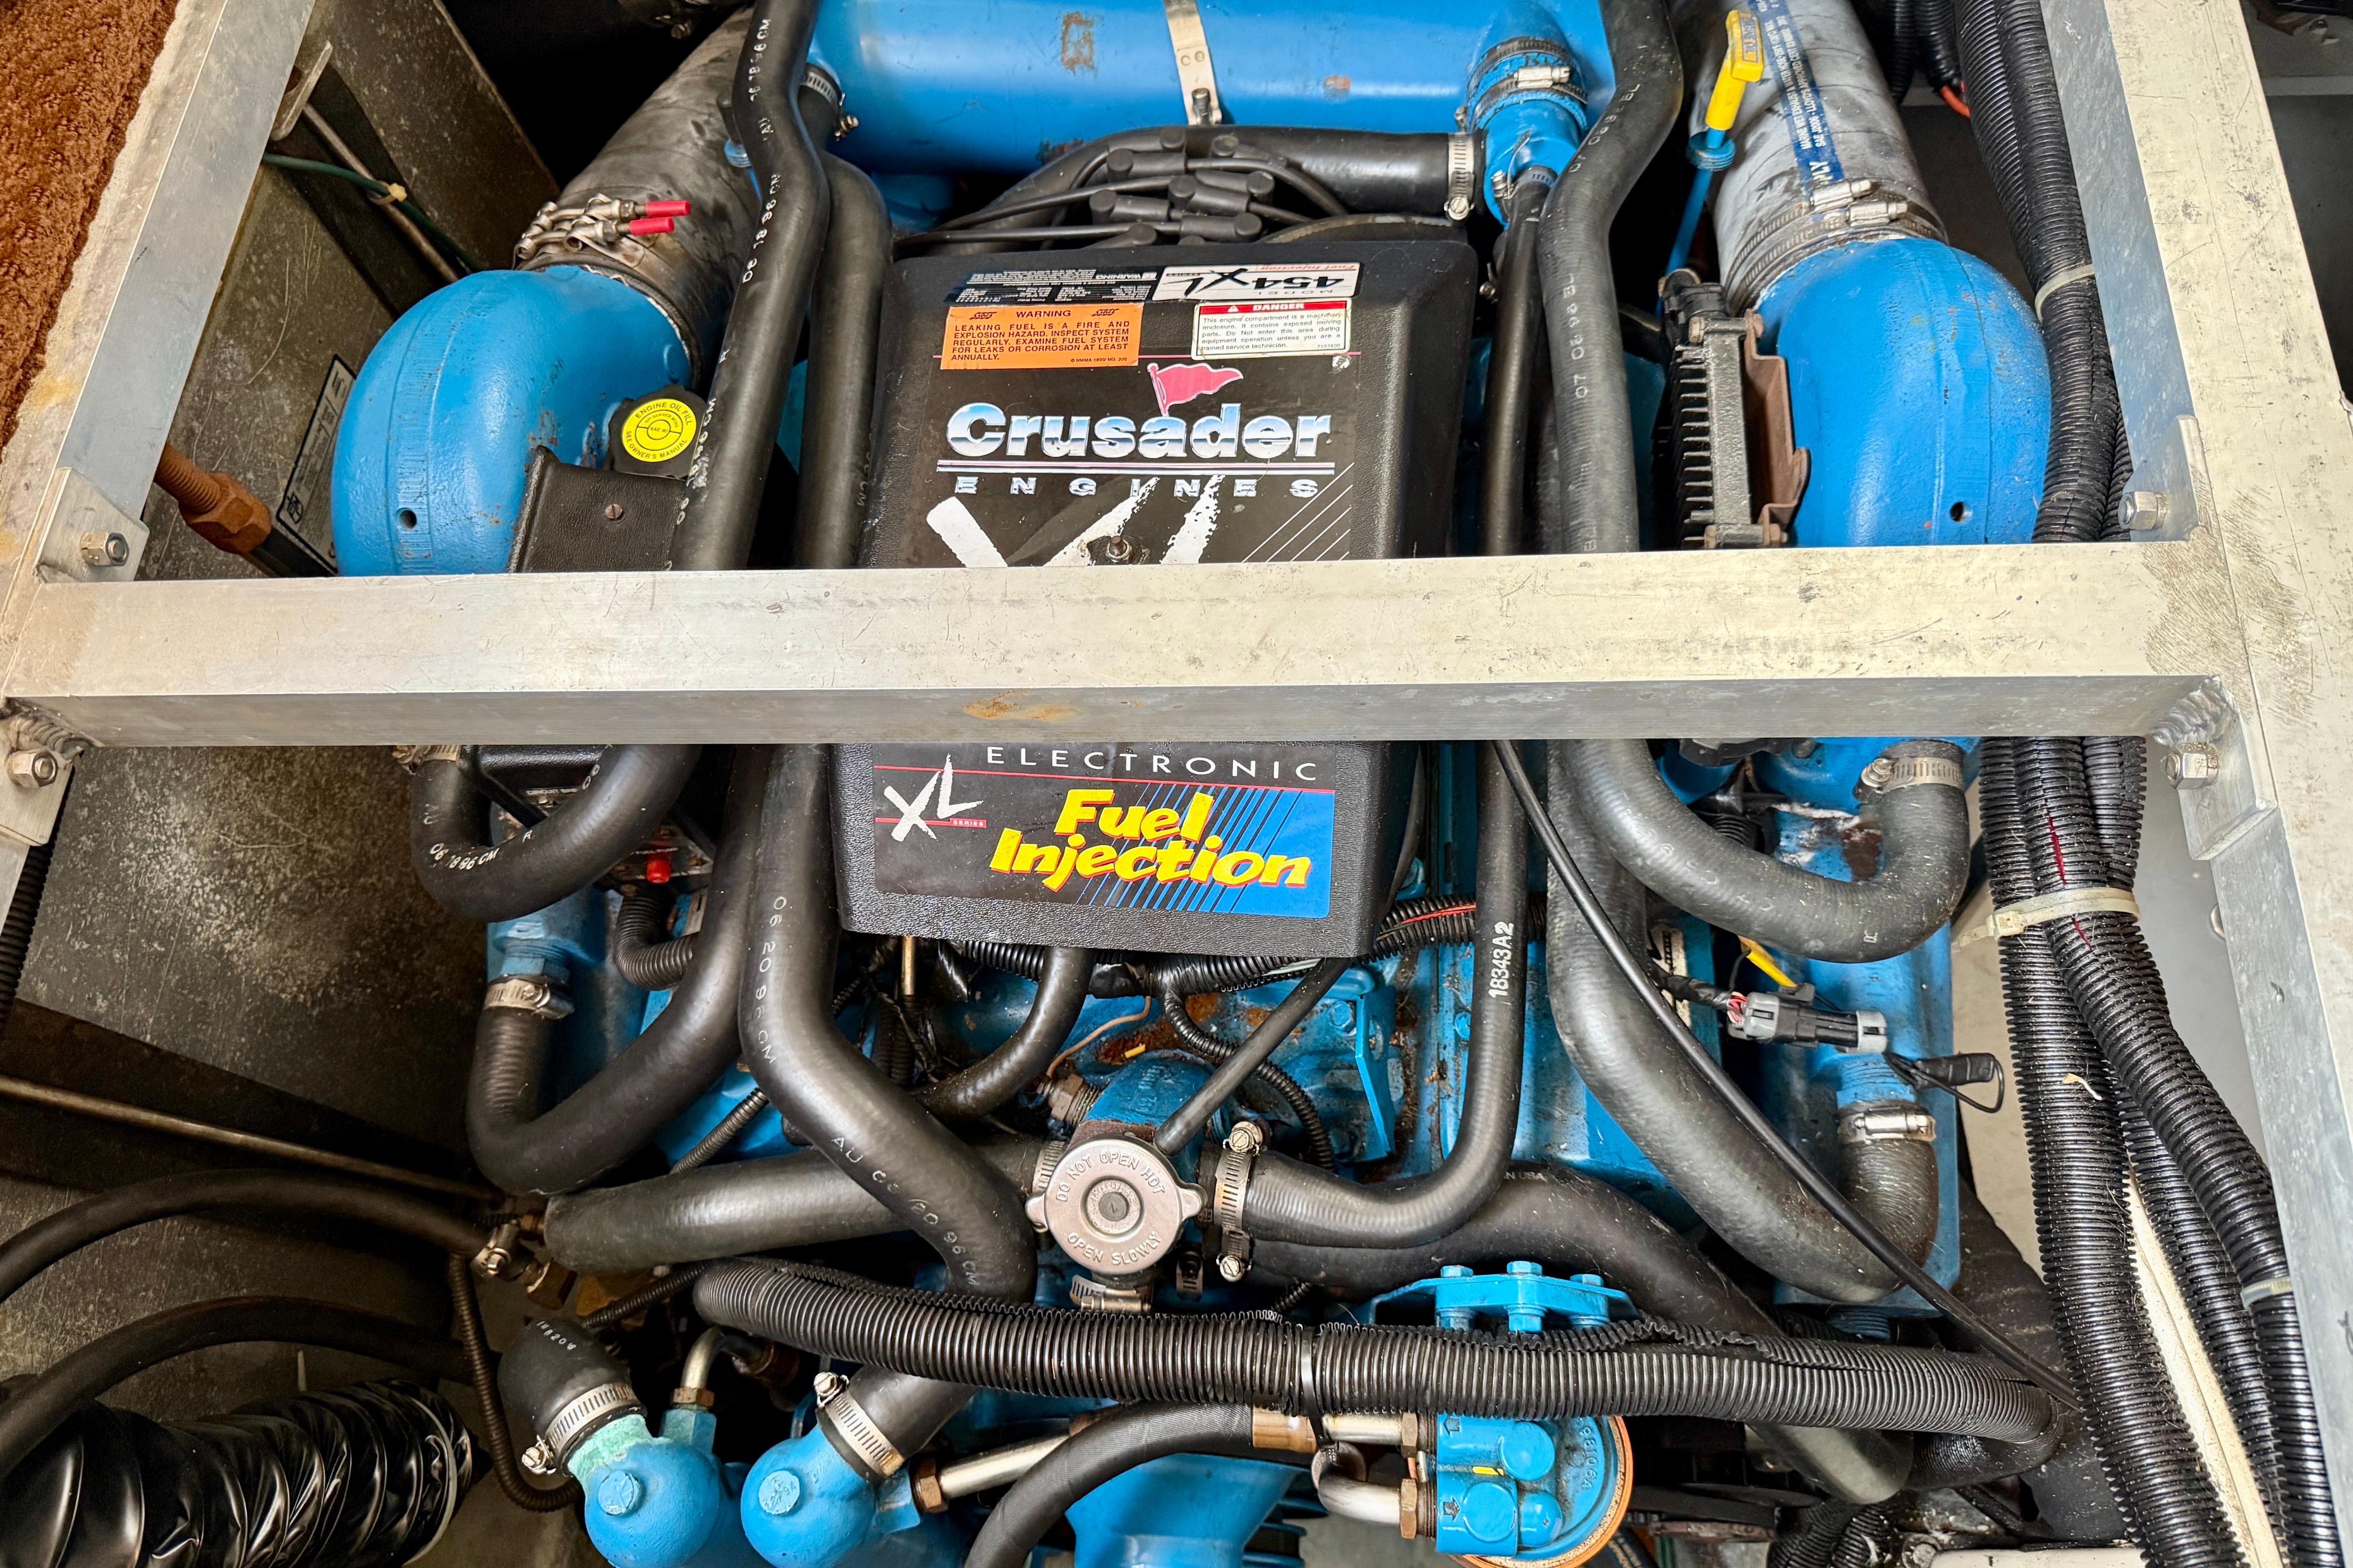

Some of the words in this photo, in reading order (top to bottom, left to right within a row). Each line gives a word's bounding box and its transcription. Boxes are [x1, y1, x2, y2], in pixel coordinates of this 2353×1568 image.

[1792, 61, 1810, 89] APPROVED
[1786, 91, 1803, 116] EXHAUST
[1800, 89, 1817, 113] LLOYD'S
[1793, 115, 1807, 129] WET
[1797, 126, 1813, 150] MARINE
[1813, 134, 1827, 147] SAE
[1162, 268, 1249, 298] XL
[1252, 276, 1344, 290] 454
[635, 402, 667, 419] ENGINE
[670, 402, 682, 412] OIL
[682, 410, 693, 426] FILL
[946, 402, 1332, 459] Crusader
[629, 443, 657, 459] OWNER'S
[660, 439, 687, 458] MANUAL
[955, 474, 1319, 498] ENGINES
[988, 746, 1317, 782] ELECTRONIC
[884, 753, 984, 842] XL
[1054, 789, 1215, 843] Fuel
[989, 827, 1311, 892] Injection
[759, 941, 776, 973] 20
[1488, 921, 1514, 998] 18343A2
[758, 1030, 777, 1064] CM
[1056, 1180, 1071, 1202] DO
[1067, 1154, 1093, 1180] NOT
[1099, 1148, 1140, 1170] OPEN
[1140, 1167, 1166, 1194] HOT
[831, 1136, 864, 1163] AU
[962, 1260, 980, 1285] CM
[1067, 1232, 1104, 1263] OPEN
[1112, 1231, 1161, 1265] SLOWLY
